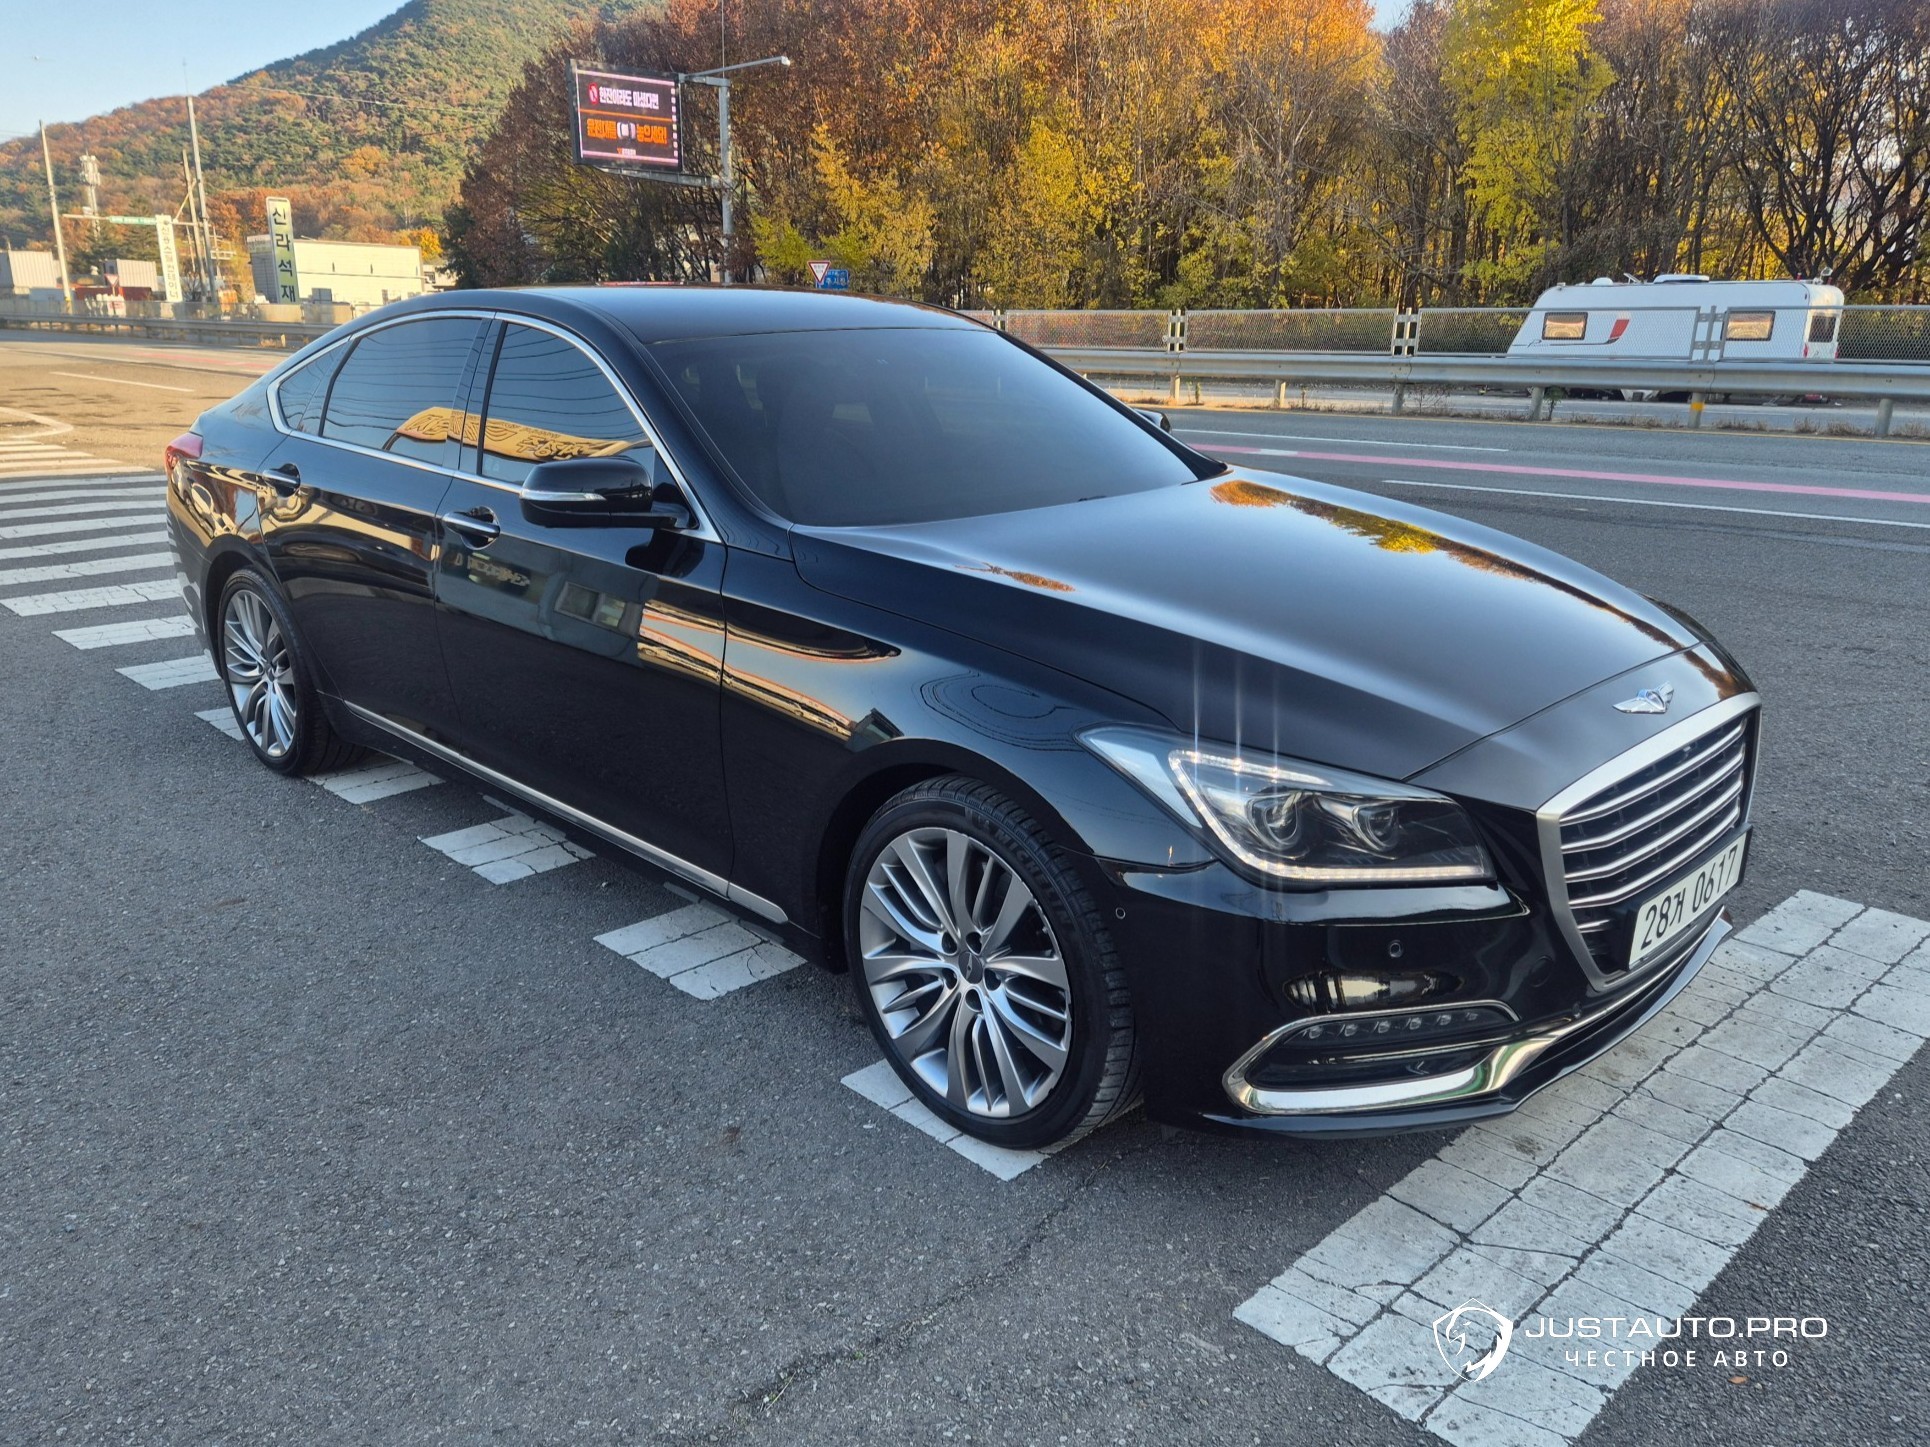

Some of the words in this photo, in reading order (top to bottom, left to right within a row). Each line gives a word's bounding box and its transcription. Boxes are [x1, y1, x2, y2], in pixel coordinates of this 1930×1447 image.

[272, 207, 296, 302] 신라석재
[994, 828, 1074, 926] MICHELIN
[1640, 887, 1687, 950] 28거
[1692, 844, 1738, 913] 0617
